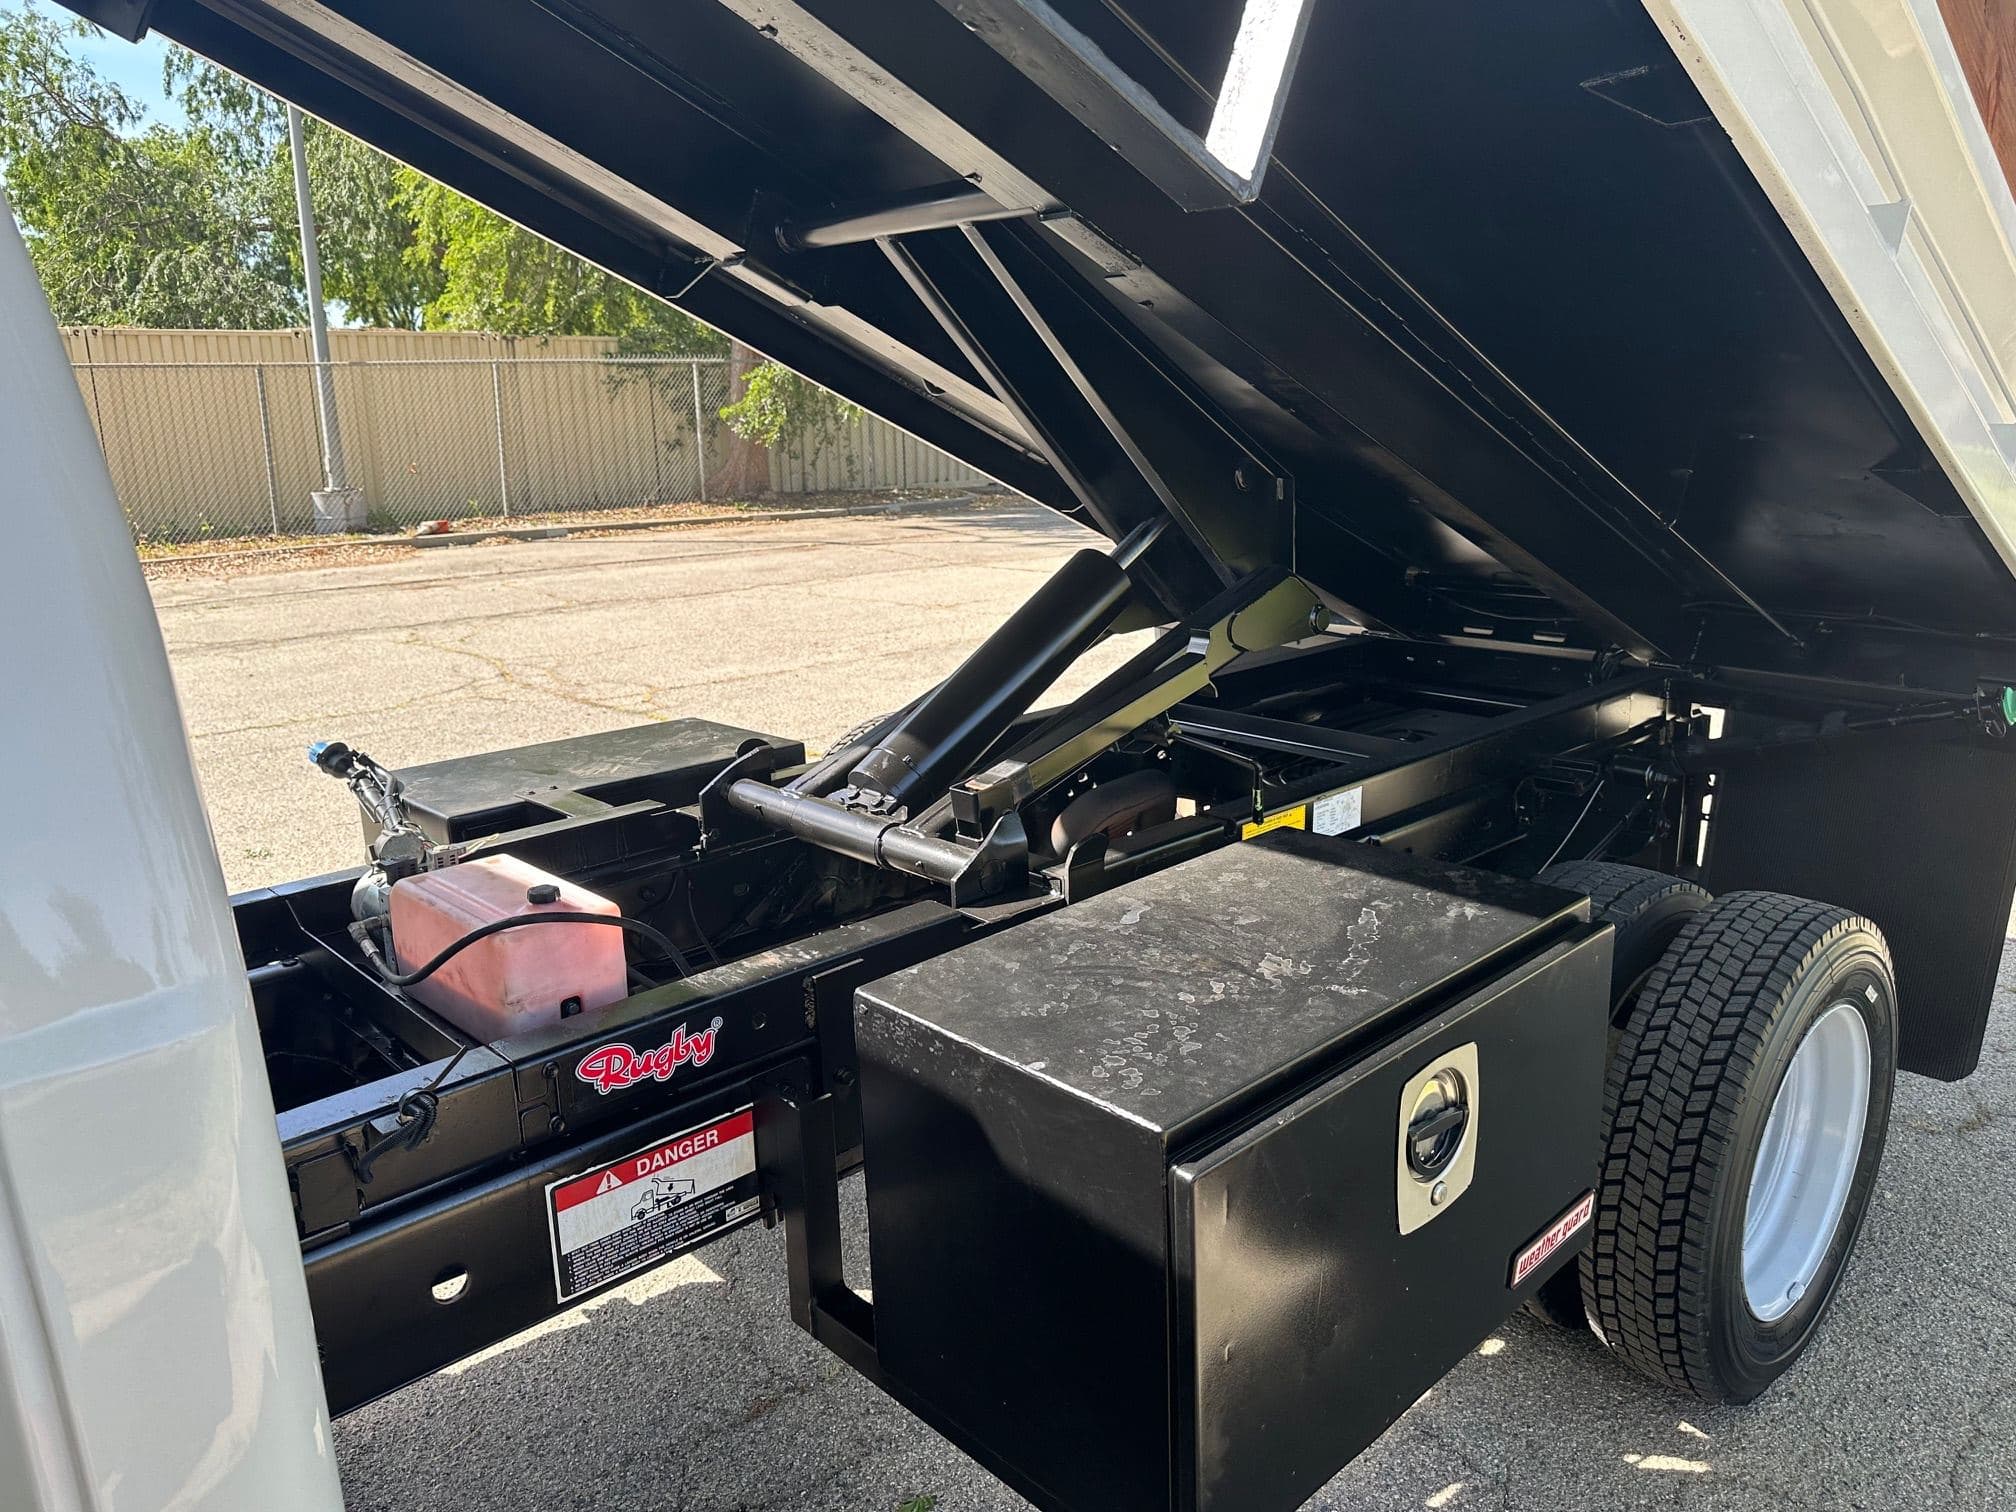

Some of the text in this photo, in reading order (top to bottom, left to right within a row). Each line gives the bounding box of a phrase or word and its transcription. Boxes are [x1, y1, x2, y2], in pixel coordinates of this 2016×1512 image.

[636, 1129, 719, 1177] DANGER
[1519, 1199, 1591, 1275] weather guard
